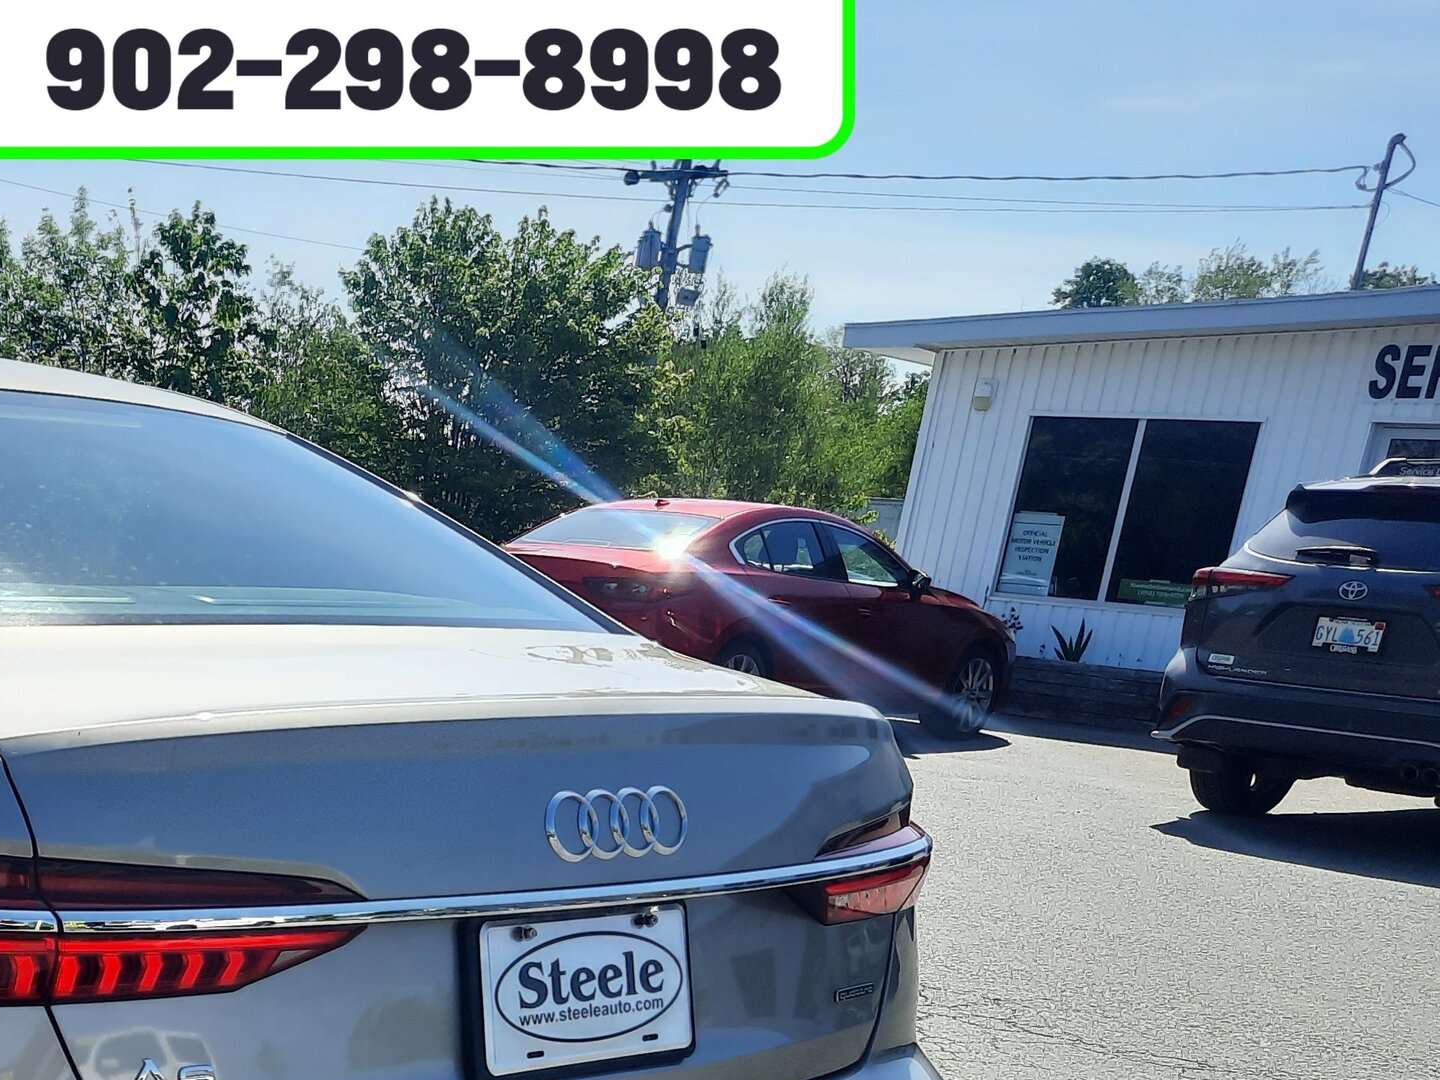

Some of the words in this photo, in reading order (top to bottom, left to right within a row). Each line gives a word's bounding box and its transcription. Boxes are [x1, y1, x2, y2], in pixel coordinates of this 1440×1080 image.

[1315, 625, 1337, 642] GYL
[1354, 629, 1380, 646] 561
[518, 951, 665, 1010] Steele
[519, 997, 664, 1026] www.steeleauto.com
